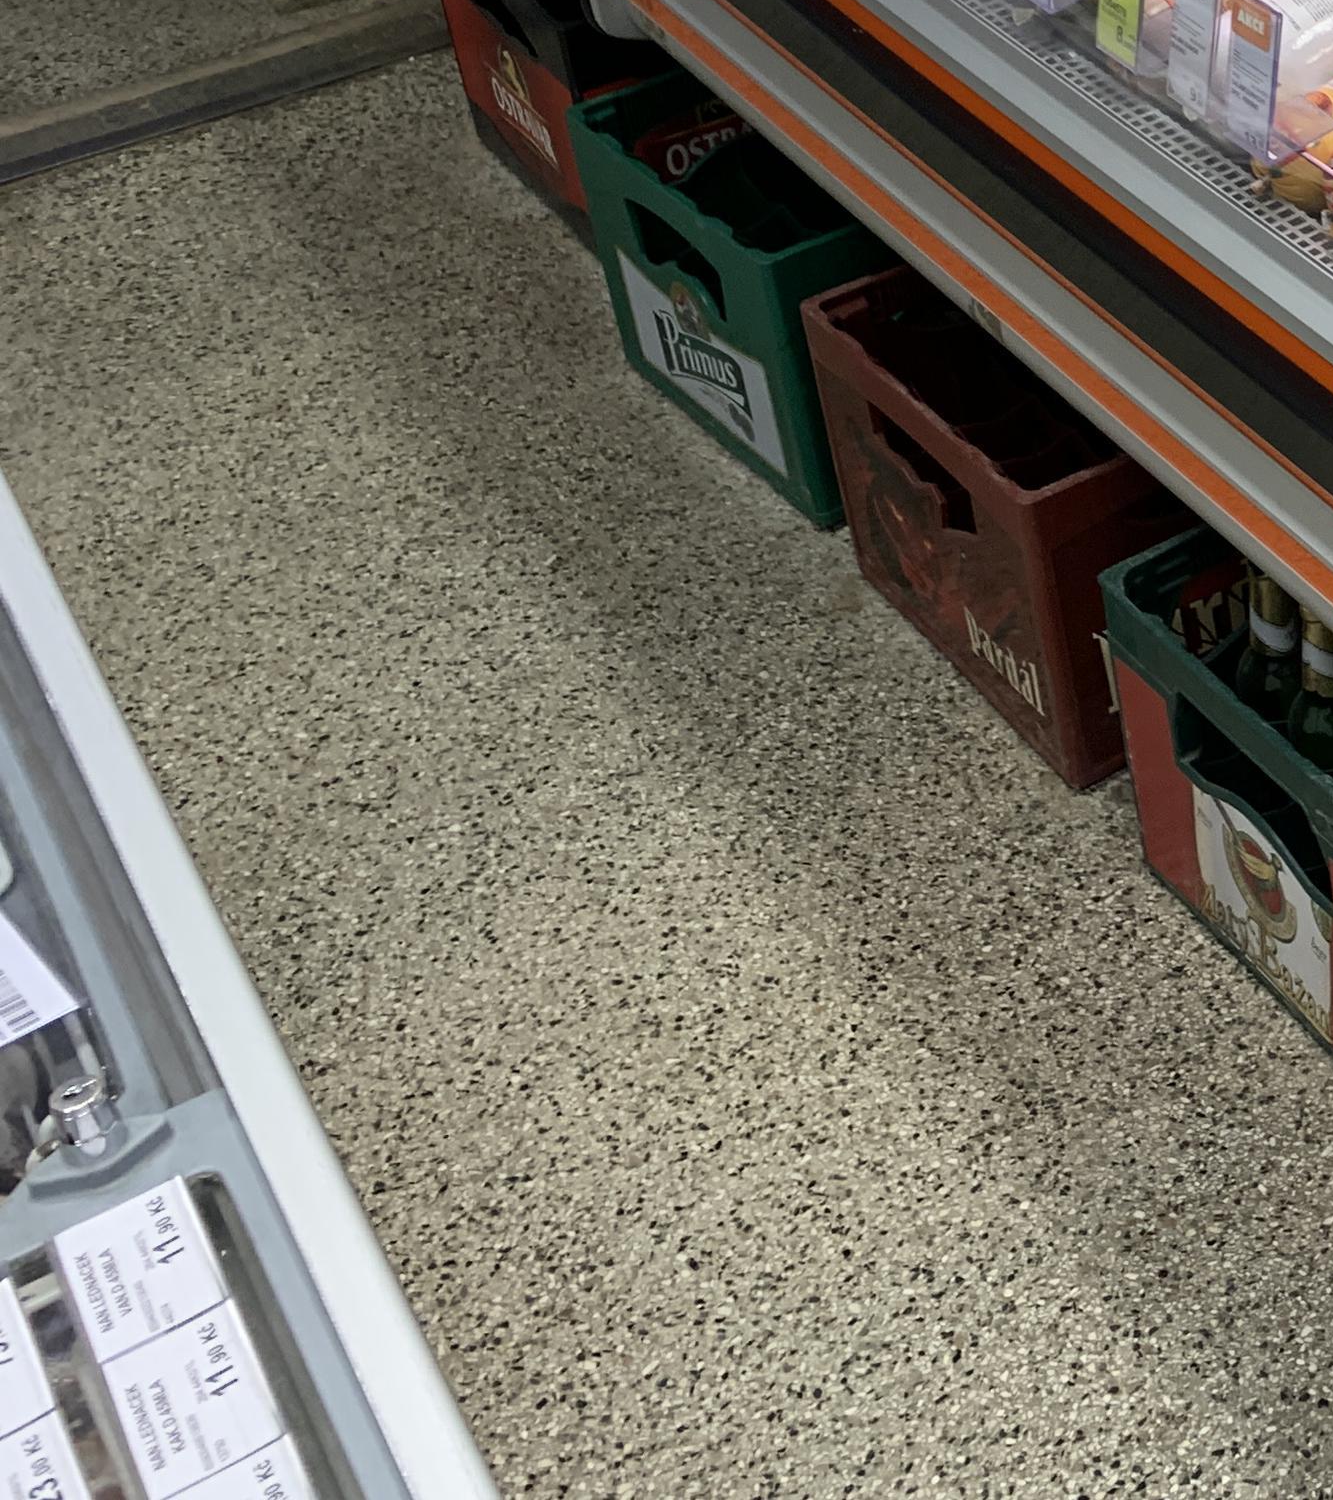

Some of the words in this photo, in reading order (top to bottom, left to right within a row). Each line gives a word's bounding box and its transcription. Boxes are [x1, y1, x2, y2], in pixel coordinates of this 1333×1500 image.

[656, 309, 739, 389] Primus
[964, 606, 1046, 717] Pardál
[145, 1194, 165, 1216] Kč
[73, 1251, 109, 1313] LEDNACEK
[124, 1382, 159, 1453] LEDNACEK
